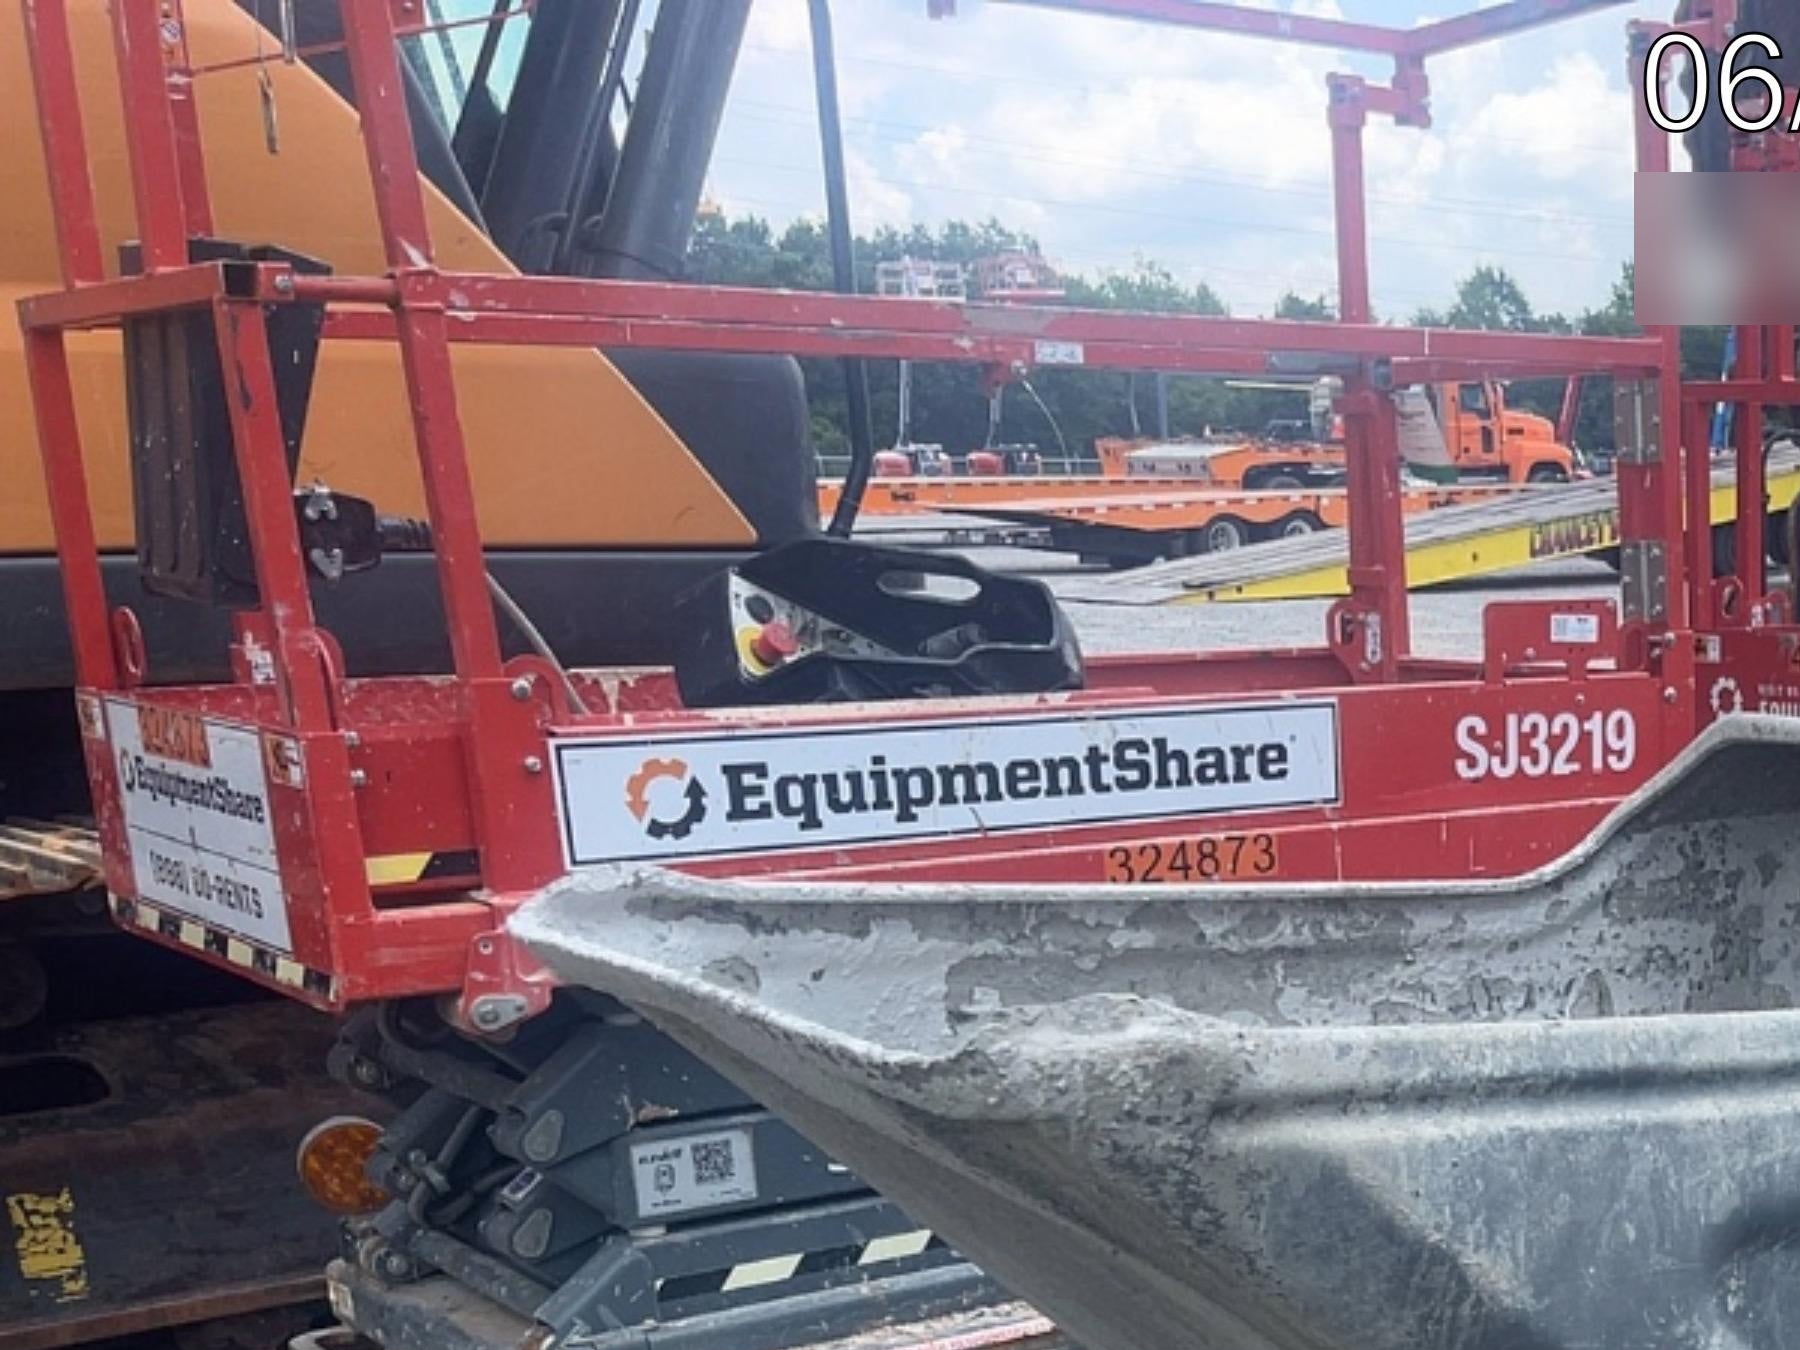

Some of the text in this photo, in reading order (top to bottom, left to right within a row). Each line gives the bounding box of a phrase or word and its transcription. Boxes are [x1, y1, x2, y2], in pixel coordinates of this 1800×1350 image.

[1455, 709, 1636, 780] SJ3219
[722, 738, 1290, 829] EquipmentShare
[1109, 834, 1277, 883] 324873
